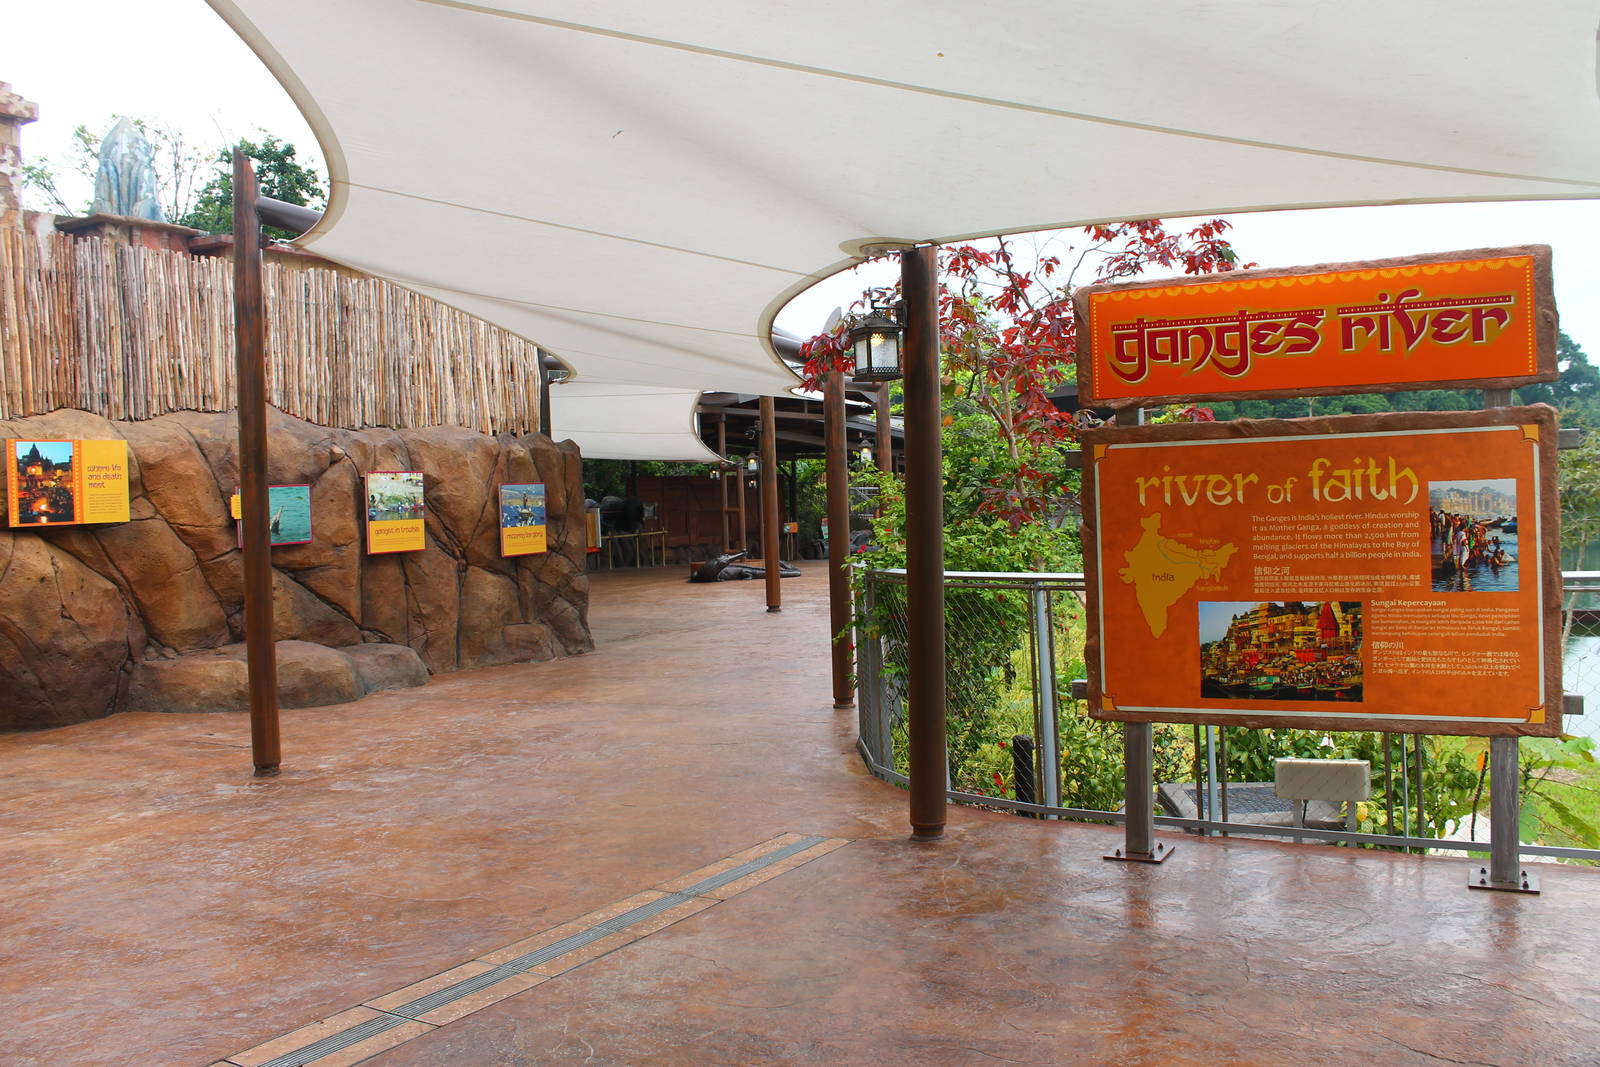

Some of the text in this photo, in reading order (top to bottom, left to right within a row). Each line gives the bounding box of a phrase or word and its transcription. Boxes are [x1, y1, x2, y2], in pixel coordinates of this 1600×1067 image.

[1109, 288, 1515, 384] ganges river
[1135, 456, 1419, 507] river of faith
[1266, 515, 1290, 523] Ganges
[1321, 513, 1344, 521] holiest
[1391, 512, 1419, 520] worship
[1297, 524, 1322, 533] Ganga,
[1330, 523, 1360, 532] goddess
[1252, 543, 1280, 551] melting
[1281, 543, 1309, 551] glaciers
[1333, 542, 1371, 550] Himalayas
[1396, 541, 1410, 549] Bay
[1253, 553, 1278, 561] Bengal,
[1293, 553, 1324, 561] supports
[1368, 551, 1392, 559] people
[1254, 566, 1291, 576] 信仰之河
[1152, 573, 1175, 582] India
[1371, 600, 1446, 608] Sungai Kepercayaan
[1372, 641, 1404, 649] 信仰の川
